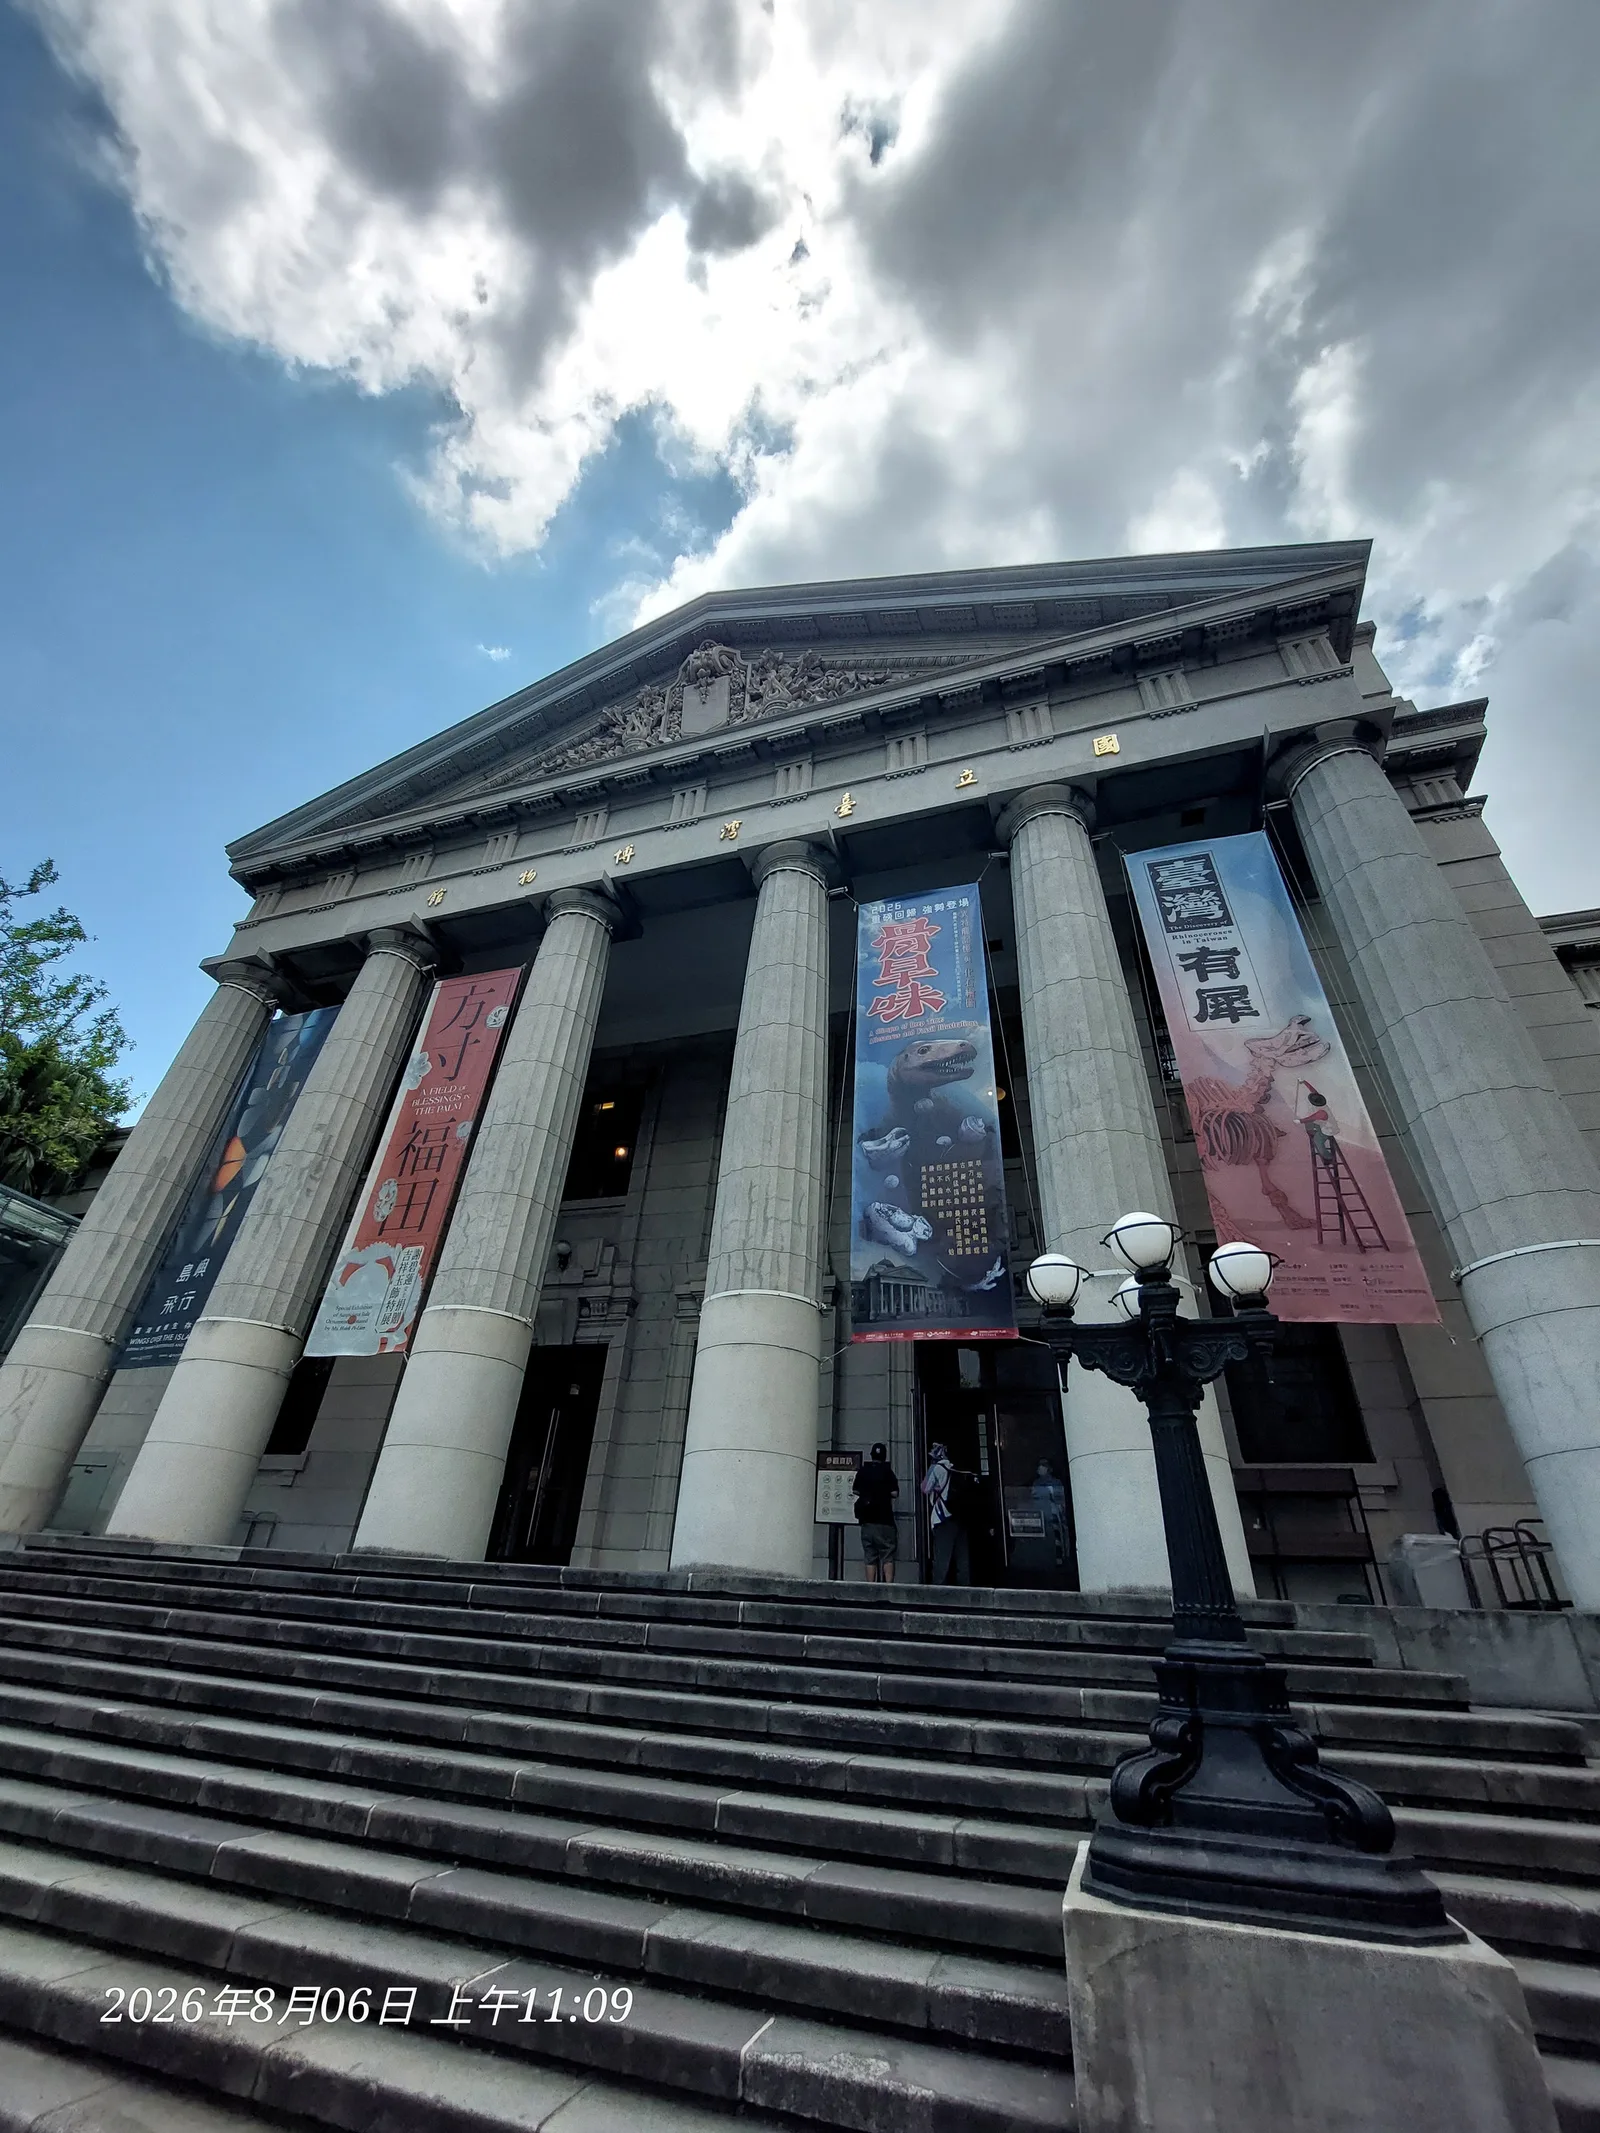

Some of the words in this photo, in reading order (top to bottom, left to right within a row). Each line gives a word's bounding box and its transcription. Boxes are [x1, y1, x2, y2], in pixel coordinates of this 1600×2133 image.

[871, 902, 901, 915] 2026
[1172, 930, 1233, 940] Rhinoceroses
[433, 985, 495, 1082] 方寸
[430, 1085, 457, 1095] FIELD
[411, 1093, 462, 1107] BLESSINGS
[415, 1106, 434, 1116] THE
[437, 1102, 463, 1113] PALM
[378, 1117, 457, 1237] 福田
[160, 1290, 197, 1315] 飛行
[129, 1337, 150, 1345] WINGS
[163, 1333, 174, 1341] THE
